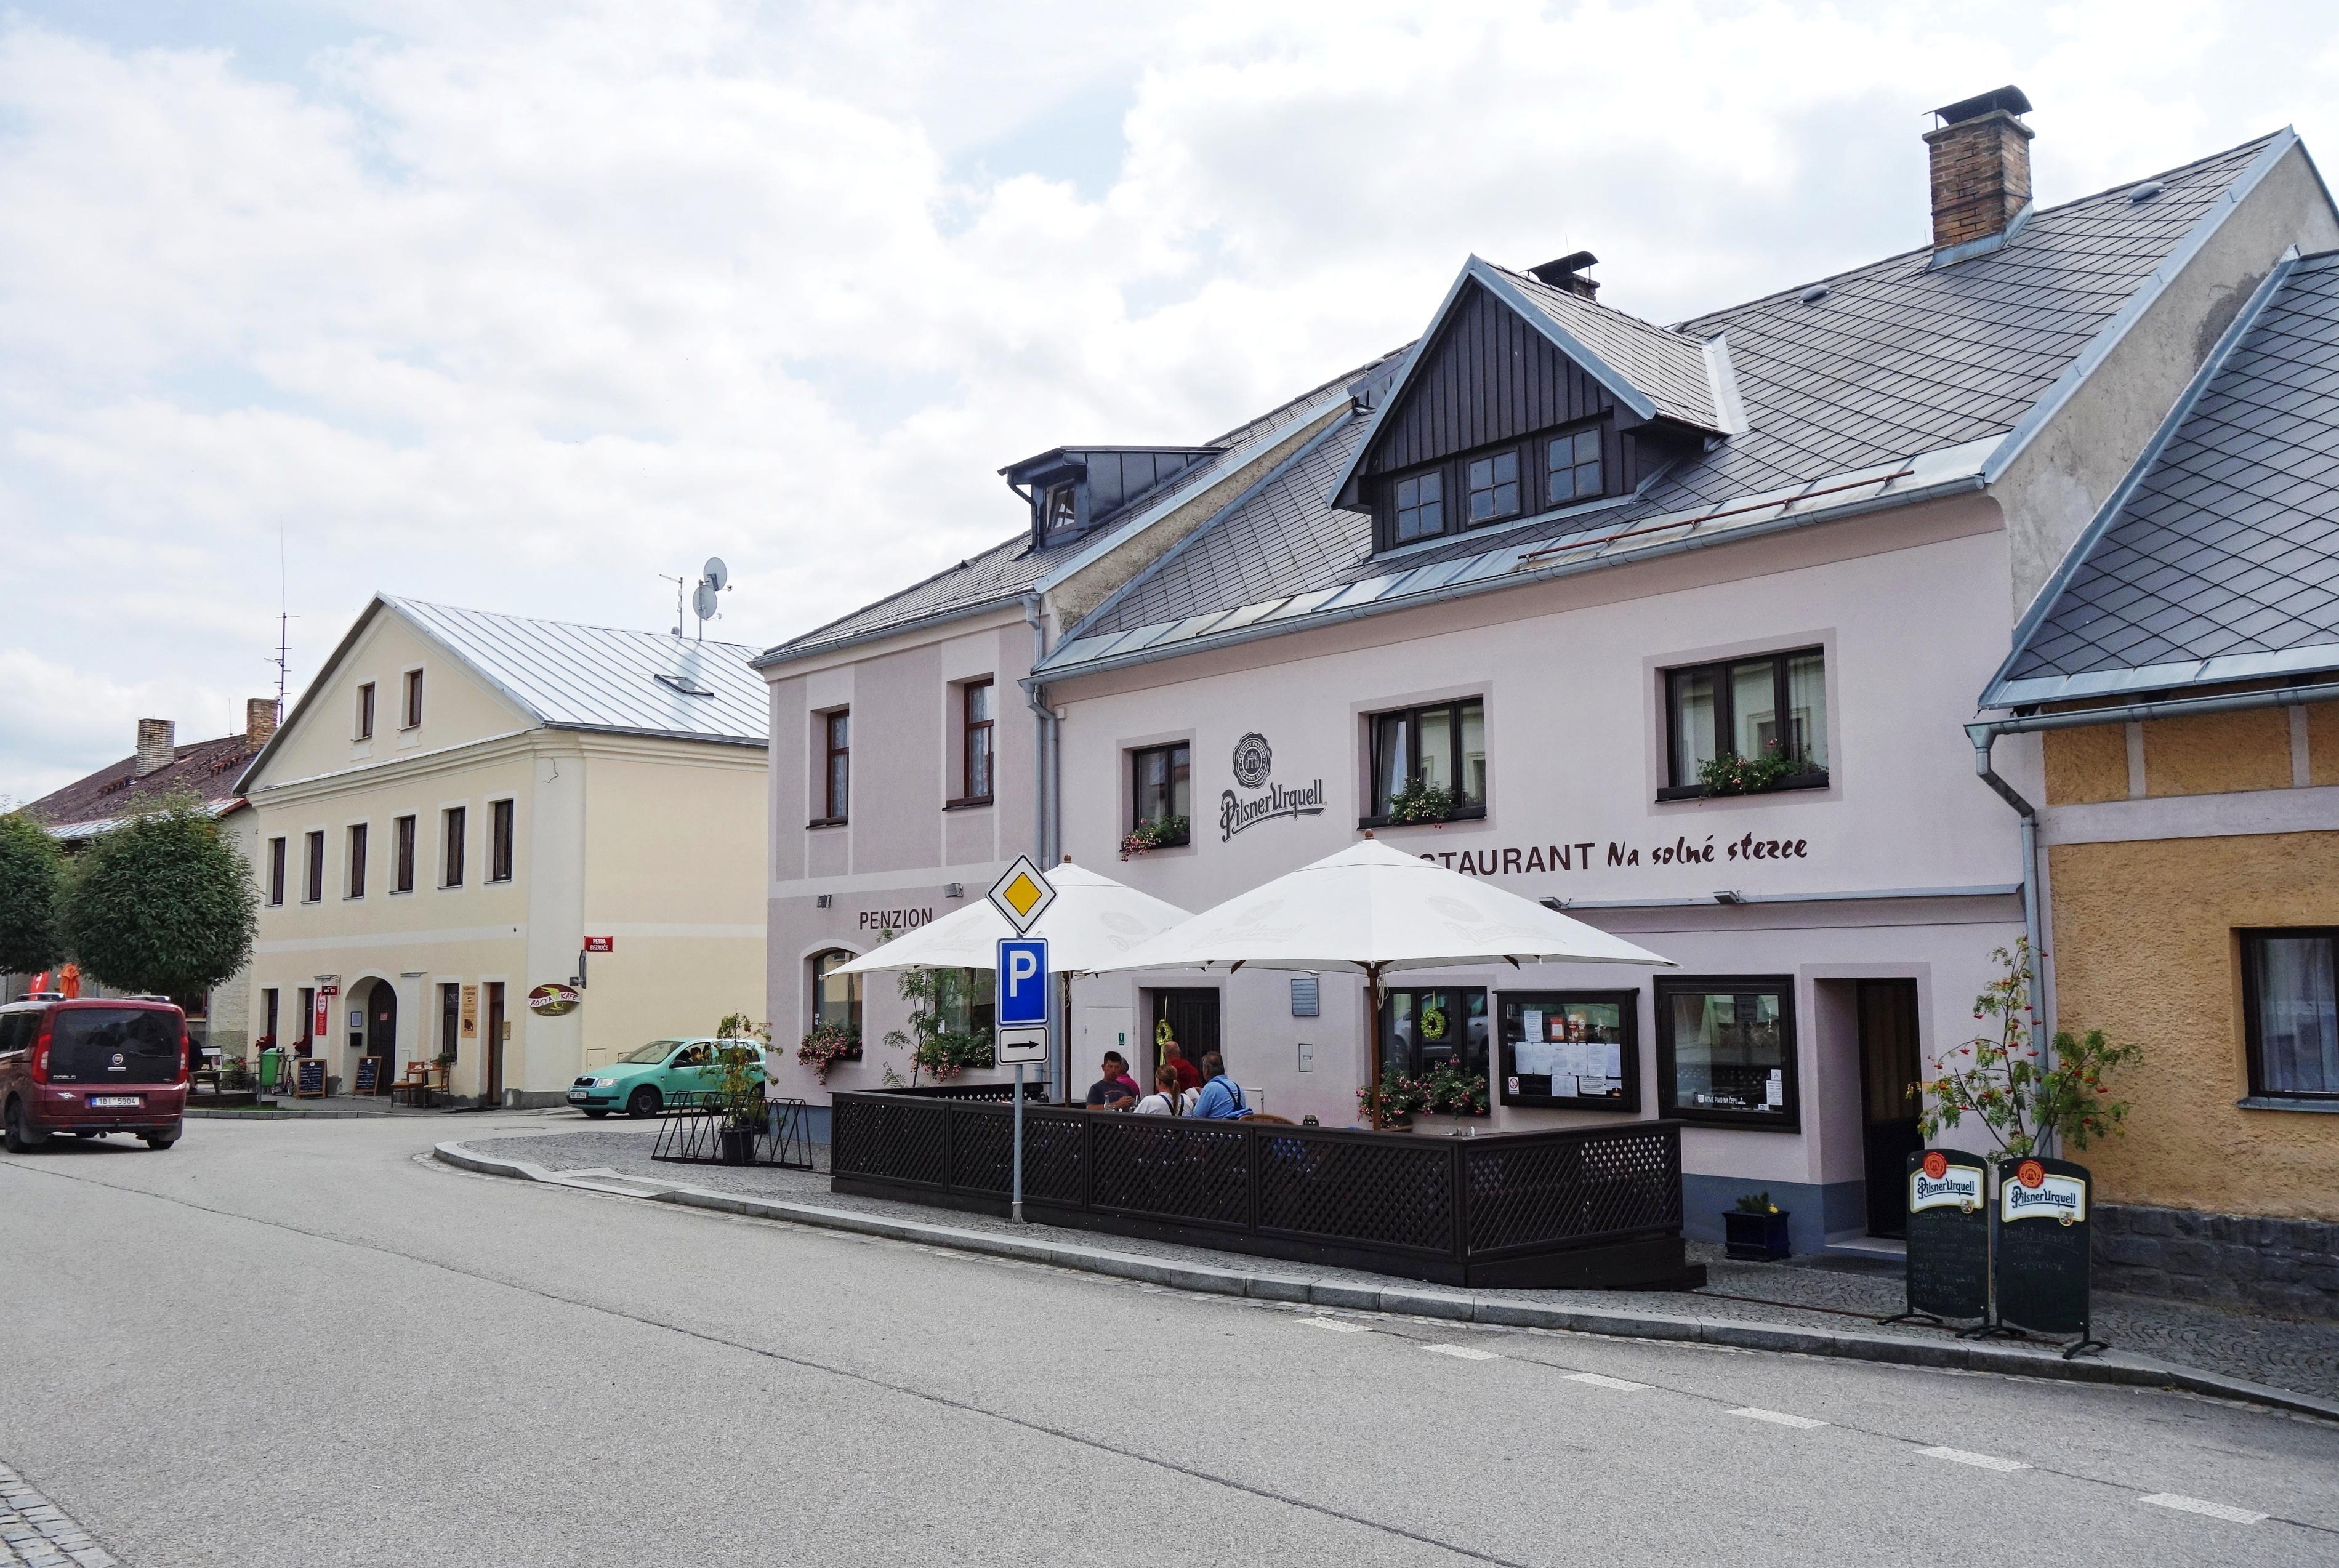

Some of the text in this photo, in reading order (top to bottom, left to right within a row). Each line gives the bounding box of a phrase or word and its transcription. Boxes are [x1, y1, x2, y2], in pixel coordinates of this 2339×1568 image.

[1220, 779, 1323, 842] Pilsner Urquell
[1420, 832, 1808, 875] TAURANT Na solné stezce
[860, 907, 933, 930] PENZION
[1010, 951, 1037, 997] P
[560, 992, 578, 1000] KAFE
[1729, 1096, 1738, 1104] ČEPU
[1918, 1176, 1975, 1200] Pilsner Urquell
[2011, 1186, 2076, 1208] Pilsner Urquell
